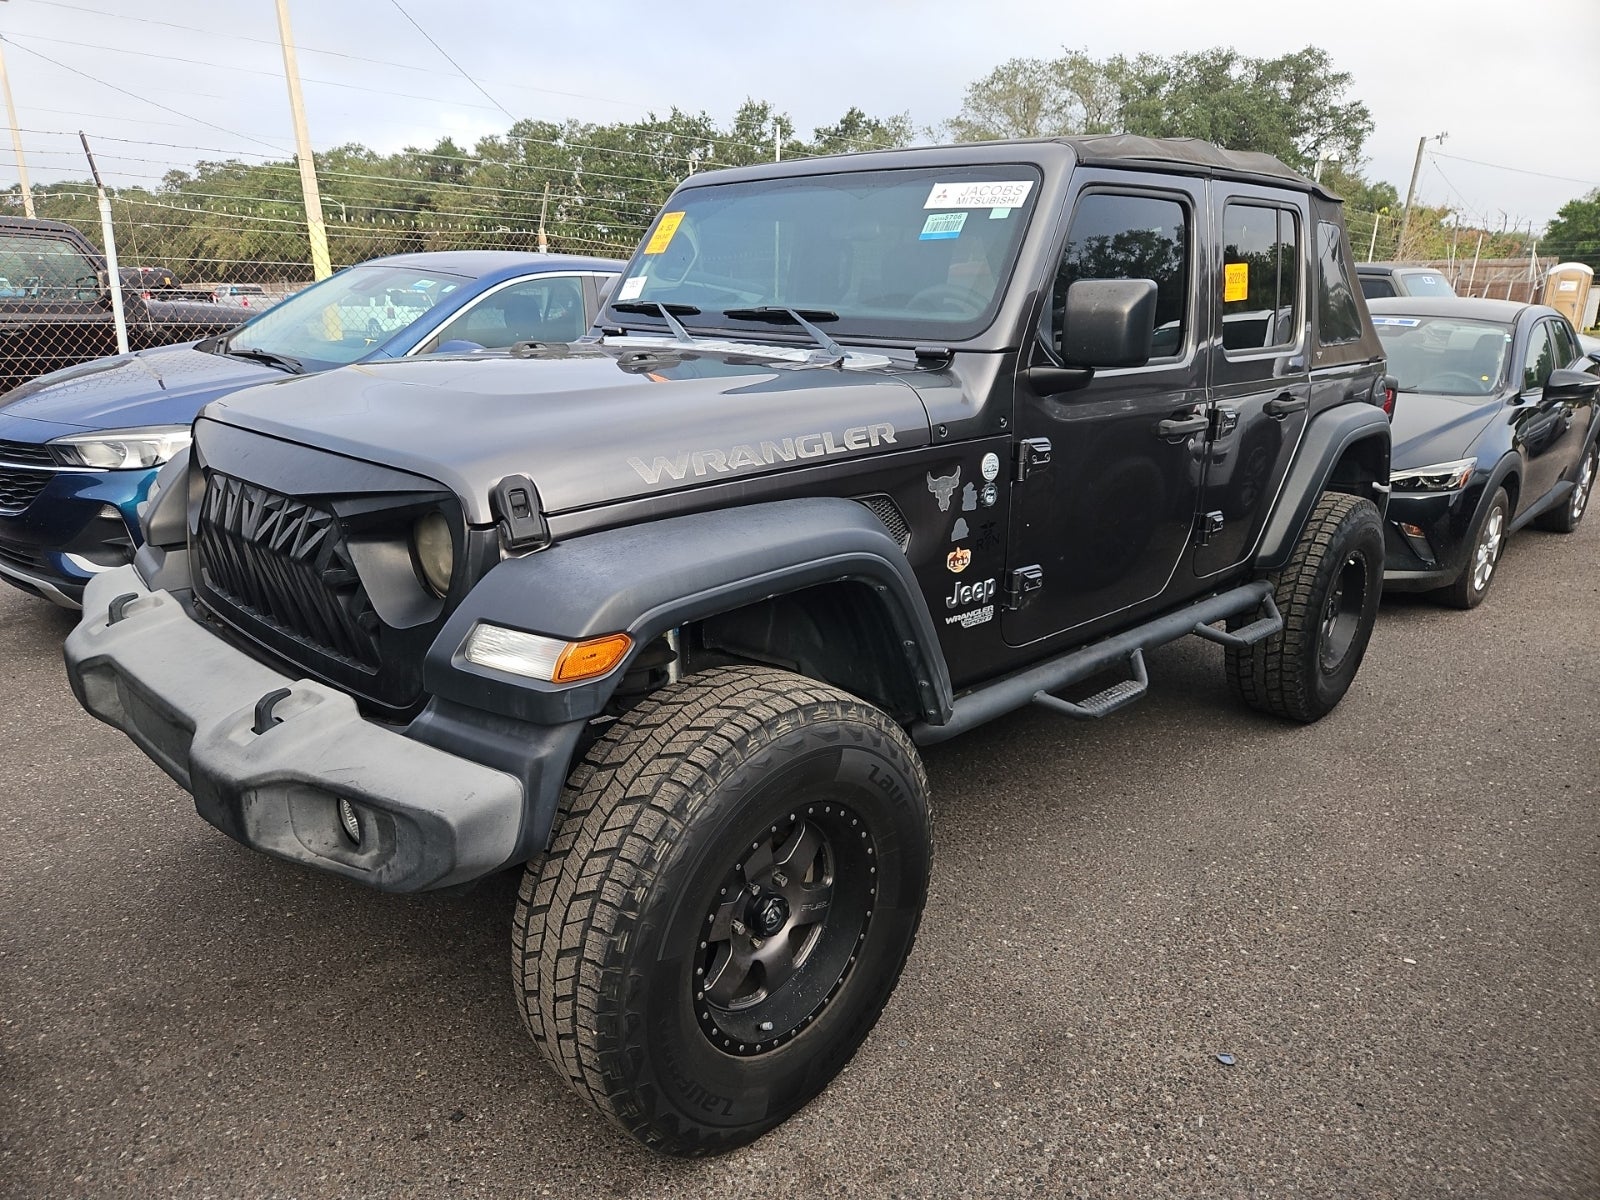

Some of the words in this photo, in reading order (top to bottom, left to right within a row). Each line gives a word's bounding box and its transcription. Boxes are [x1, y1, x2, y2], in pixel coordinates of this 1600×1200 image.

[956, 196, 1019, 205] MITSUBISHI
[961, 185, 1024, 196] JACOBS
[626, 422, 898, 485] WRANGLER
[946, 578, 997, 609] Jeep
[945, 605, 994, 625] WRANGLER
